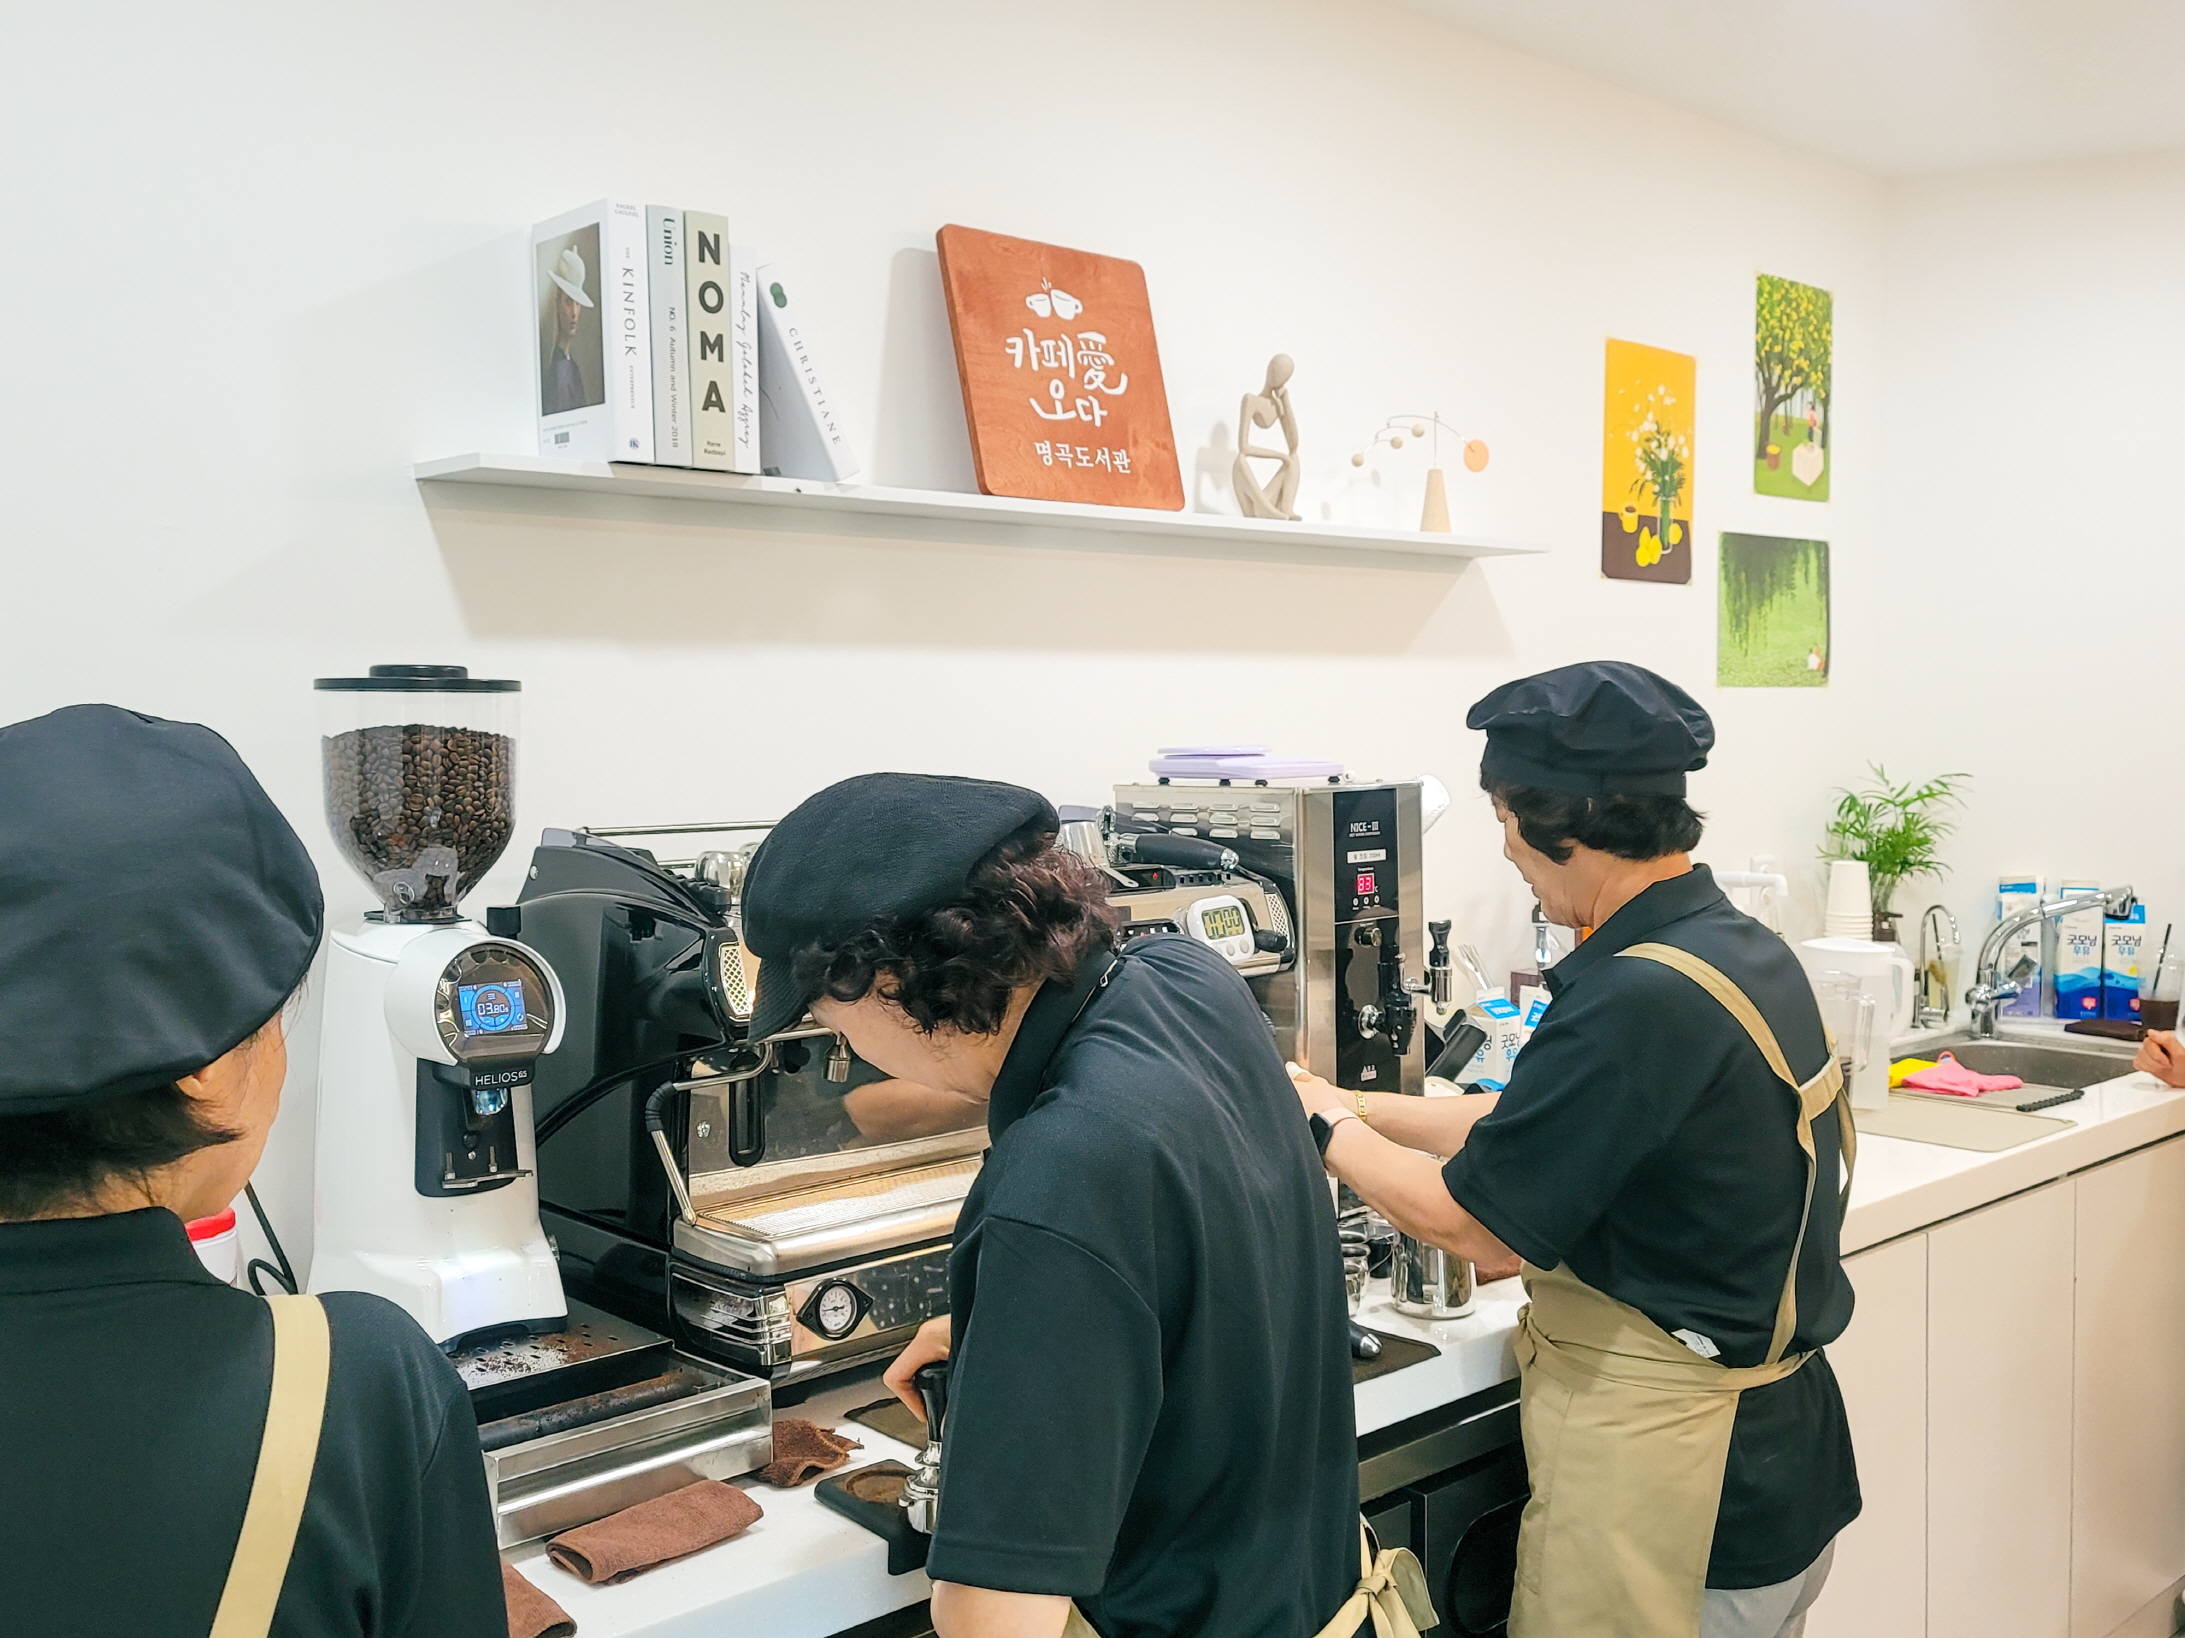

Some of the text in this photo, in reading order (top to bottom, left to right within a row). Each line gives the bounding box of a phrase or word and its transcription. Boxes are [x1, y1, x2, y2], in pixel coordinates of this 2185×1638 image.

[663, 218, 678, 266] Union
[622, 267, 637, 356] KINFOLK
[698, 230, 726, 413] NOMA
[669, 336, 677, 372] Autumn
[669, 374, 677, 392] and
[789, 327, 842, 445] CHRISTIANE
[670, 394, 678, 424] Winter
[1028, 378, 1108, 428] 오다
[671, 426, 679, 449] 2018
[1033, 439, 1132, 475] 명곡도서관
[2066, 934, 2098, 948] 굿모닝
[2110, 934, 2142, 948] 굿모닝
